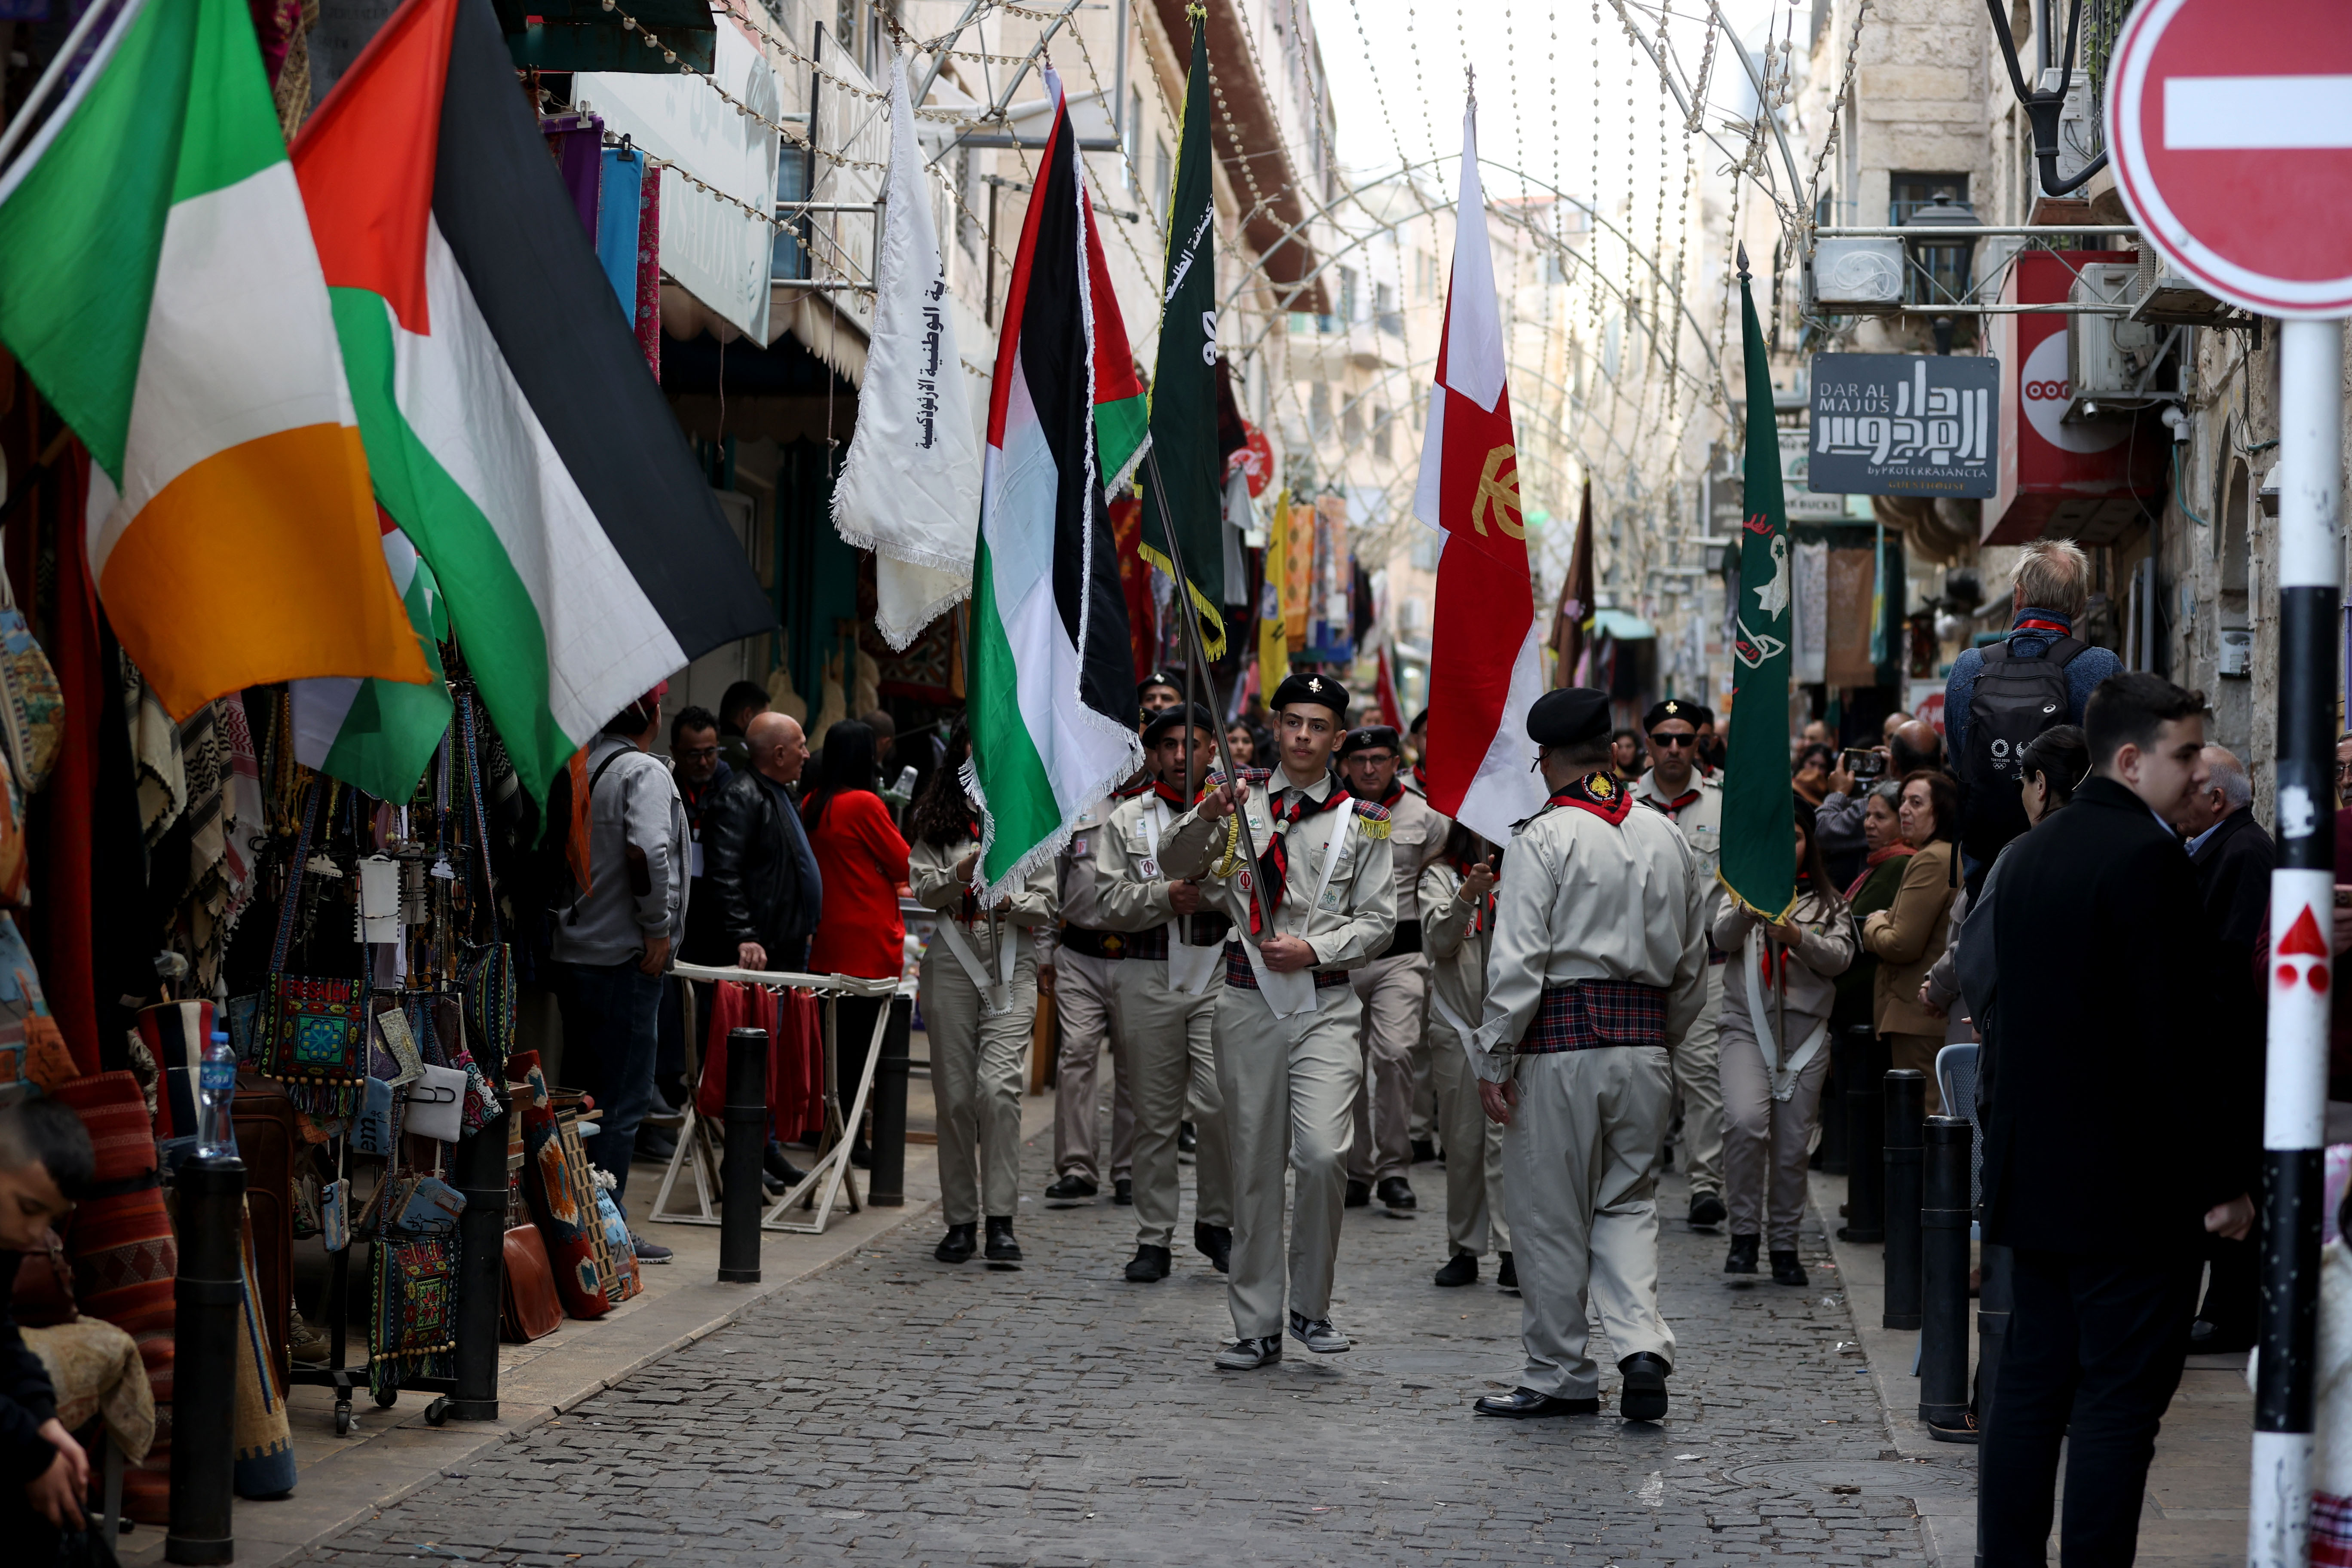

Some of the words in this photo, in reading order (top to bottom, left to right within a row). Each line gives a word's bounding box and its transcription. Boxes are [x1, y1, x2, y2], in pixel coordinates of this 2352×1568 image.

[920, 306, 944, 377] الوطنية
[1820, 383, 1859, 397] DAR
[1865, 385, 1890, 398] AL
[1819, 398, 1890, 413] MAJUS
[1889, 481, 1966, 490] GUESTHOUSE
